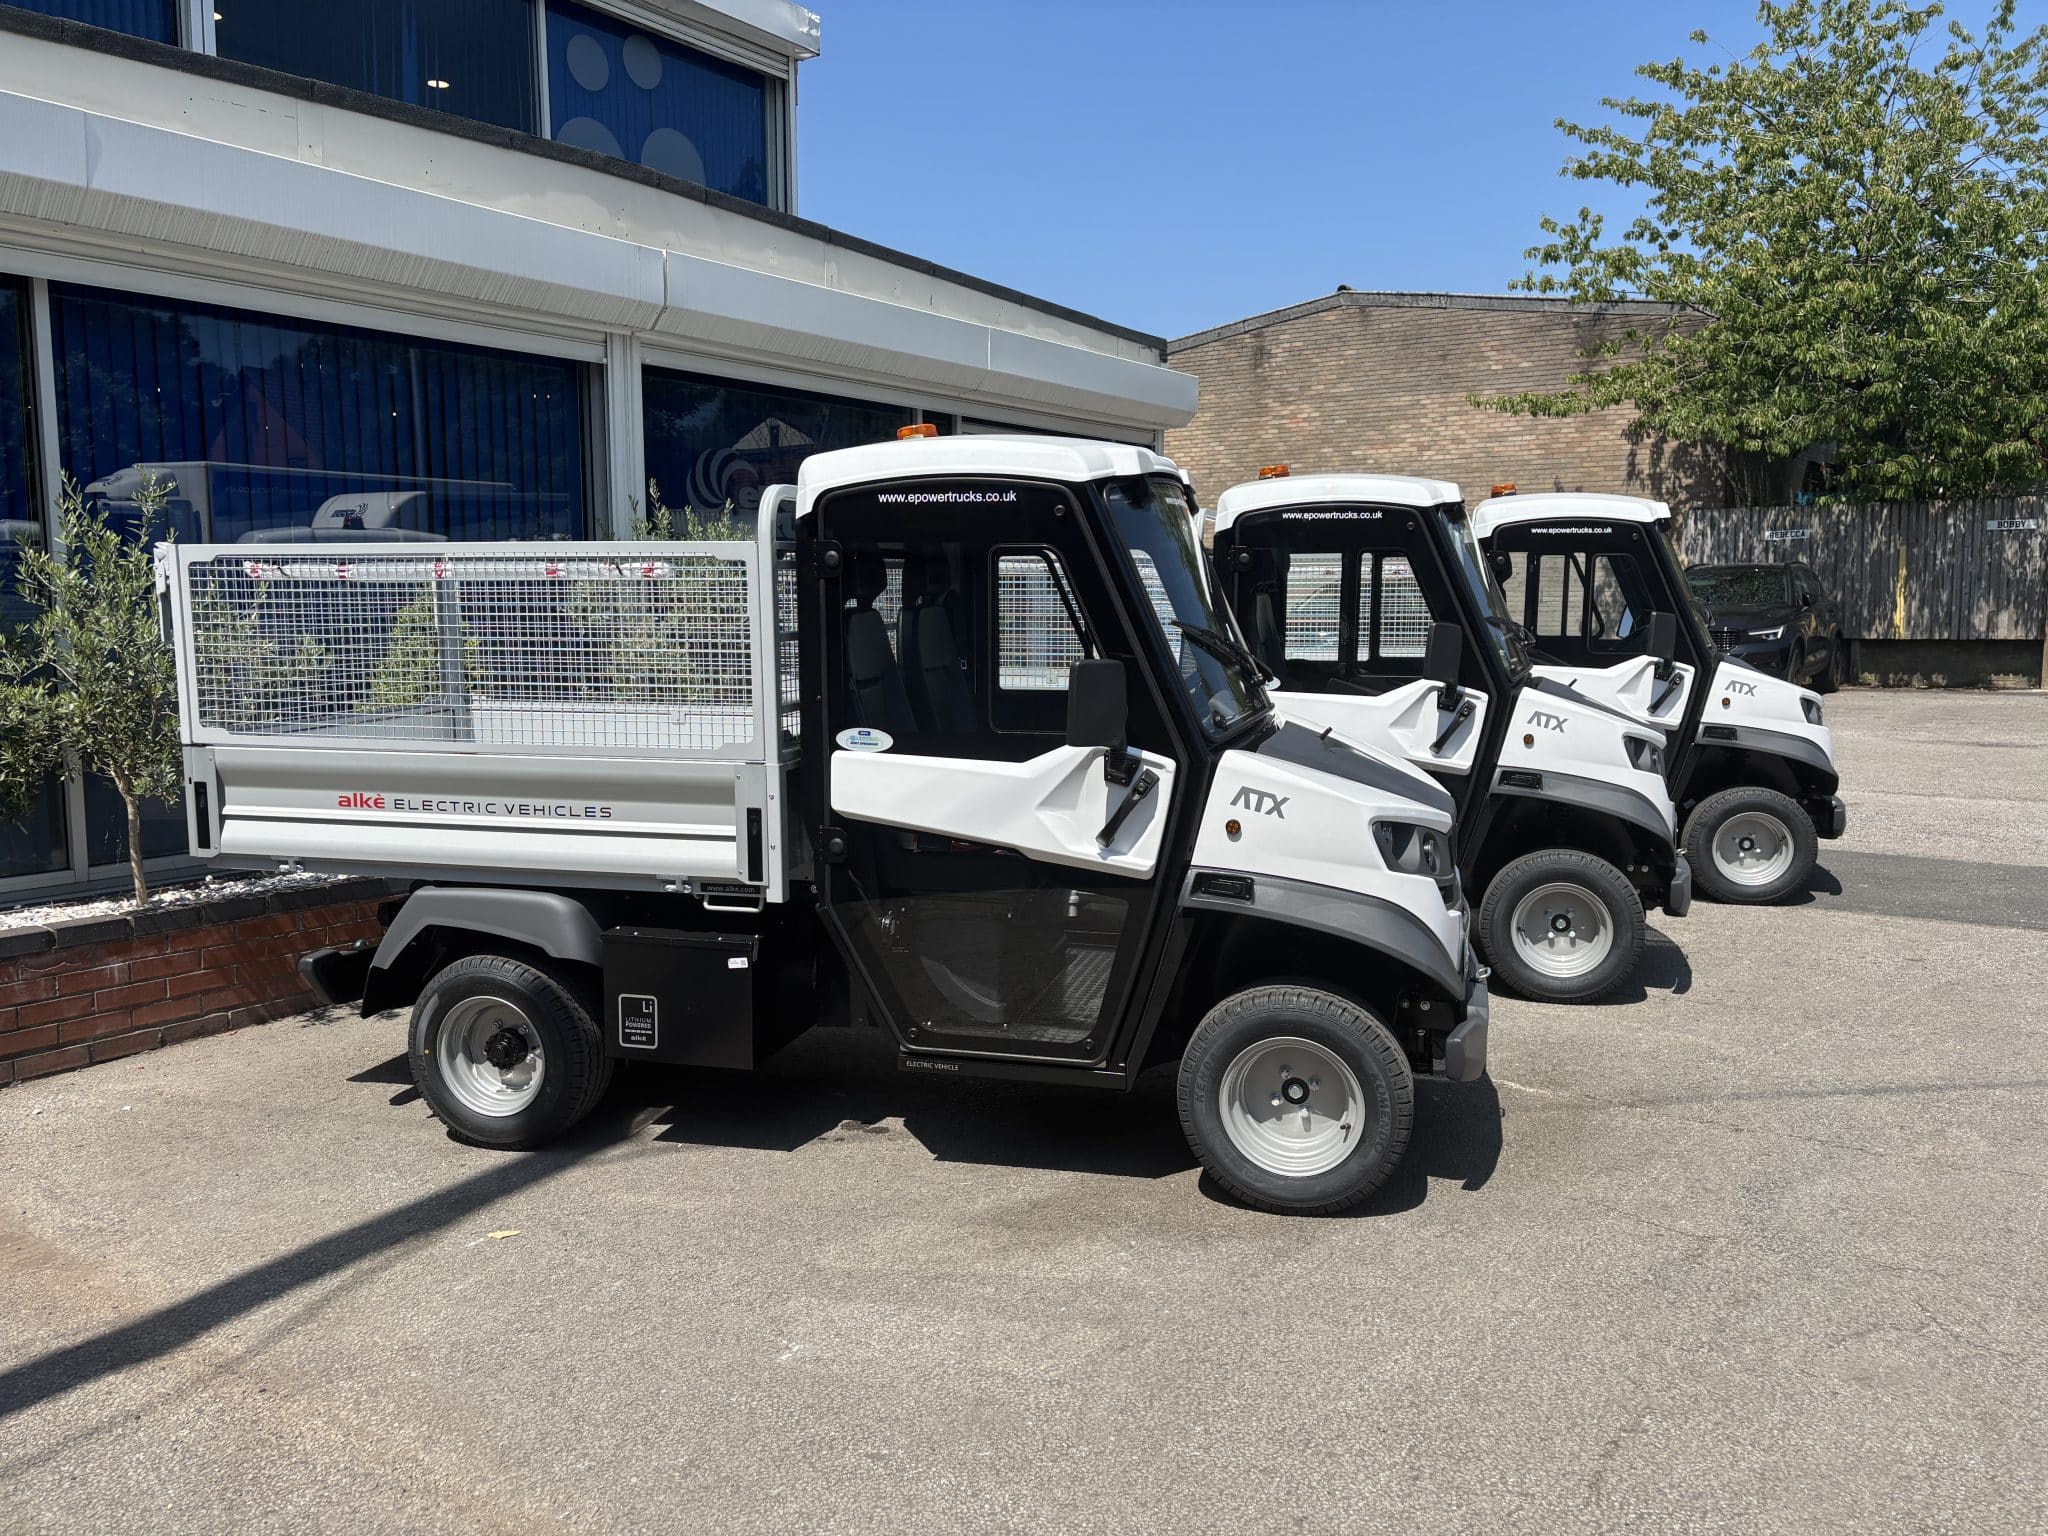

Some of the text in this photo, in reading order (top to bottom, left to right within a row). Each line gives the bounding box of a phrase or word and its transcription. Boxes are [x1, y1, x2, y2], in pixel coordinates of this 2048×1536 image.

[878, 491, 1017, 505] www.epowertrucks.co.uk
[1282, 510, 1383, 521] www.epowertrucks.co.uk
[1531, 526, 1613, 535] www.epowertrucks.co.uk
[1997, 520, 2026, 529] BOBBY
[1769, 530, 1805, 539] REBECCA
[1725, 680, 1758, 697] ATX
[1527, 711, 1568, 733] ATX
[338, 792, 613, 819] alkè ELECTRIC VEHICLES
[1230, 786, 1290, 819] ATX
[642, 1000, 653, 1013] Li
[906, 1060, 959, 1071] ELECTRIC VEHICLE
